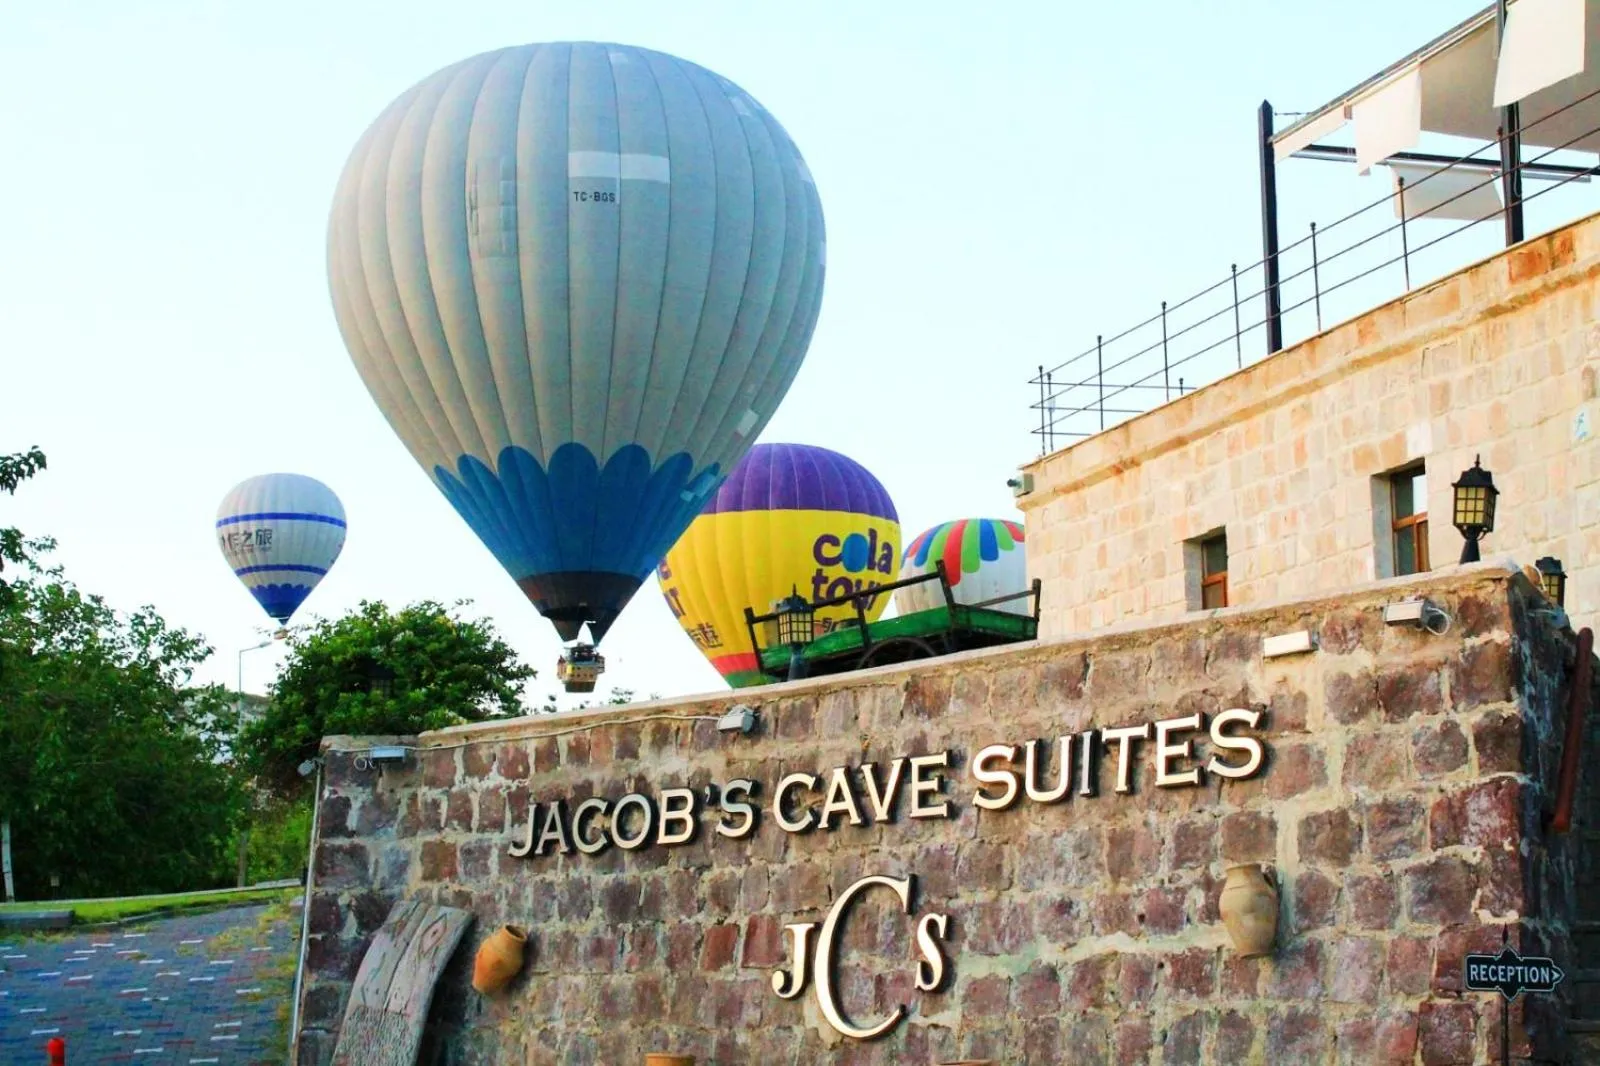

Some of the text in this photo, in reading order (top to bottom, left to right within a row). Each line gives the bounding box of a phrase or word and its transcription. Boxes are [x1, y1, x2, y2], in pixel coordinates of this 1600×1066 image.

[812, 527, 894, 575] cola
[507, 708, 1265, 857] JACOB'S CAVE SUITES
[1469, 964, 1550, 984] RECEPTION
